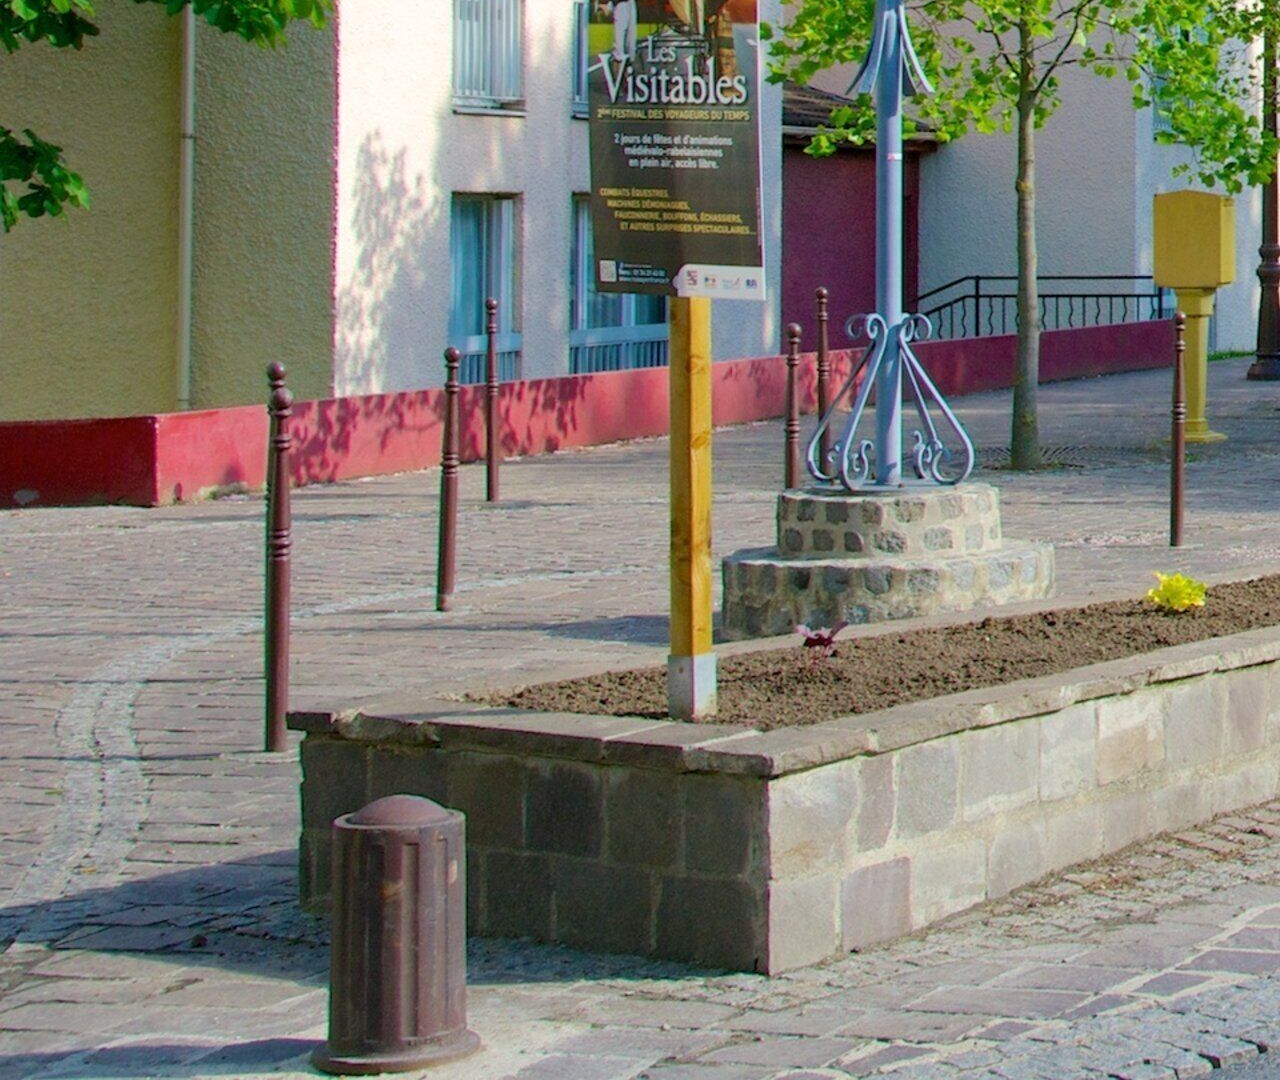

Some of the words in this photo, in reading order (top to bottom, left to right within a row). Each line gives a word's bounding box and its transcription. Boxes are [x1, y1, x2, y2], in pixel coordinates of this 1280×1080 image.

[647, 36, 676, 63] Les
[598, 53, 748, 105] Visitables
[612, 108, 646, 120] FESTIVAL
[648, 109, 664, 120] DES
[665, 109, 709, 121] VOYAGEURS
[711, 110, 722, 121] DU
[724, 110, 750, 121] TEMPS
[614, 134, 619, 144] 2
[620, 134, 641, 146] jours
[643, 134, 652, 144] de
[653, 134, 672, 145] fêtes
[674, 135, 682, 145] et
[683, 134, 733, 146] d'animations
[628, 158, 639, 167] en
[640, 157, 660, 170] plein
[661, 158, 674, 169] air,
[675, 158, 698, 169] accès
[698, 158, 720, 169] libre.
[600, 187, 630, 198] COMBATS
[607, 199, 641, 209] MACHINES
[619, 221, 629, 231] ET
[629, 222, 655, 232] AUTRES
[655, 222, 693, 233] SURPRISES
